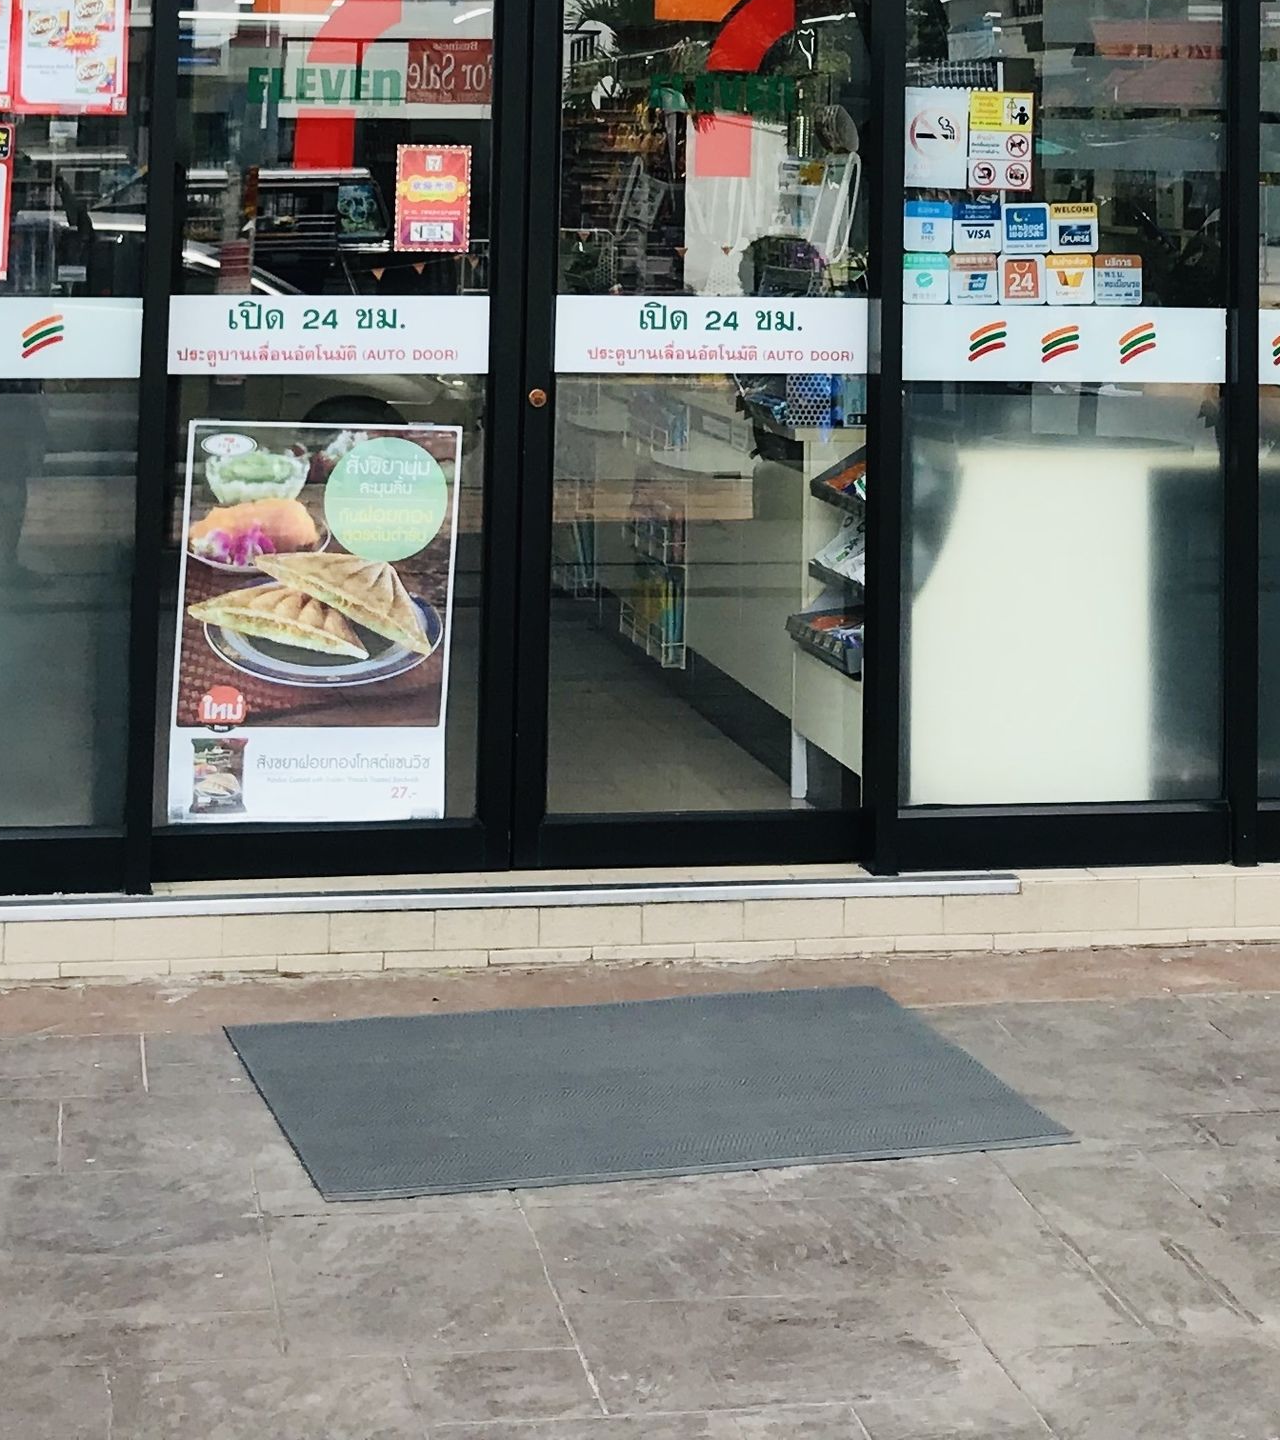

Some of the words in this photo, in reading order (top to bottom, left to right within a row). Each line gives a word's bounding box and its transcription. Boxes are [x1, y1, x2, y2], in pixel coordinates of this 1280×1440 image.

[1054, 206, 1094, 214] WELCOME
[966, 229, 991, 239] VISA
[228, 300, 285, 330] เปิด
[303, 309, 339, 330] 24
[356, 307, 406, 330] ชม.
[639, 301, 688, 331] เปิด
[705, 310, 739, 331] 24
[755, 310, 803, 332] ชม.
[362, 349, 406, 362] (AUTO
[412, 350, 458, 362] DOOR)
[762, 350, 804, 362] (AUTO
[810, 350, 855, 363] DOOR)
[203, 694, 244, 720] ใหม่
